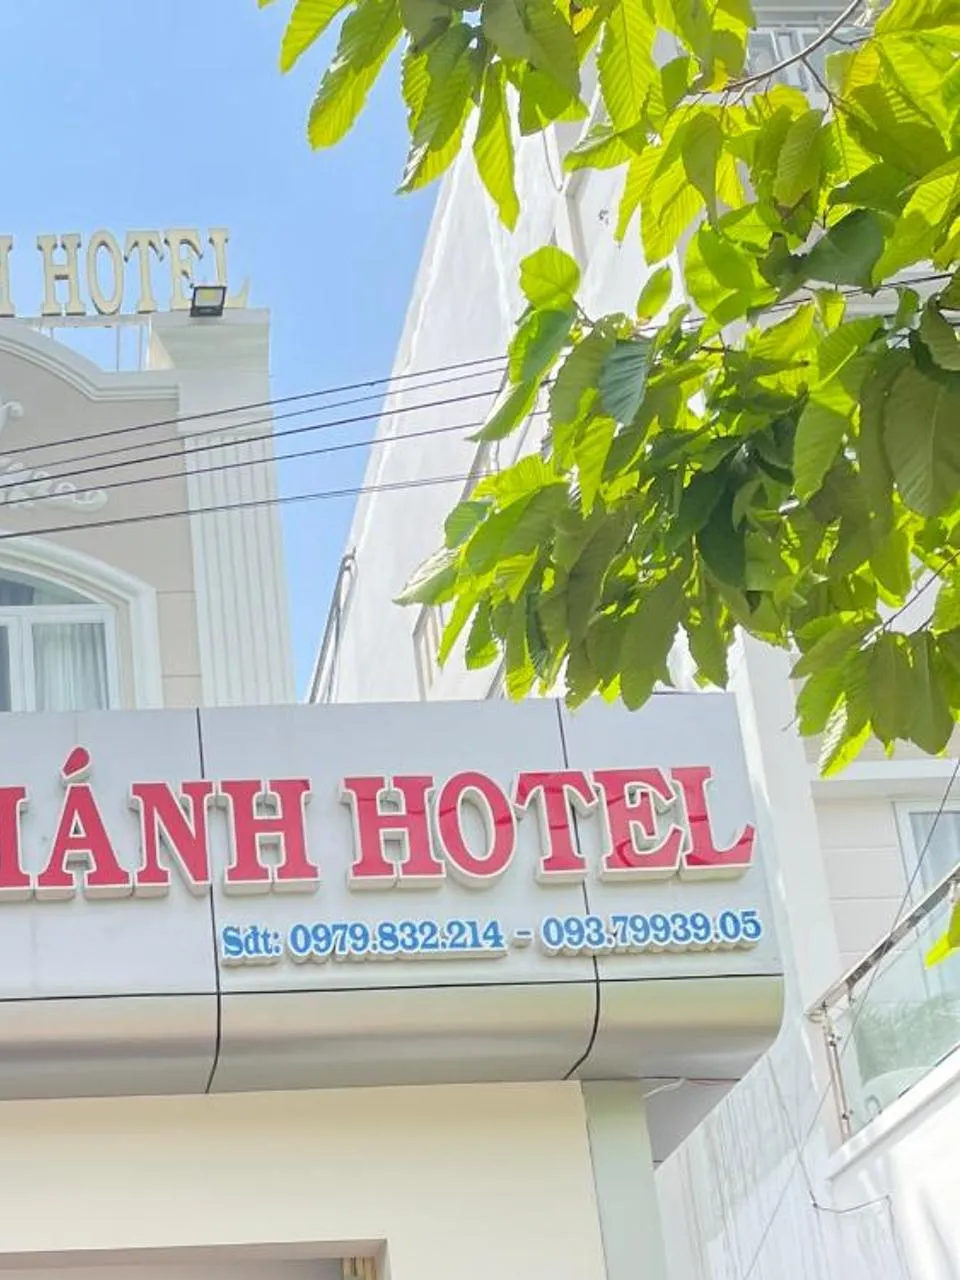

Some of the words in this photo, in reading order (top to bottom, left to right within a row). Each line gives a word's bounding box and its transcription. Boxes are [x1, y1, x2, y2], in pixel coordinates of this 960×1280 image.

[37, 227, 250, 316] HOTEL
[341, 765, 757, 879] HOTEL
[288, 919, 505, 954] 0979.832.214
[542, 909, 763, 949] 093.79939.05
